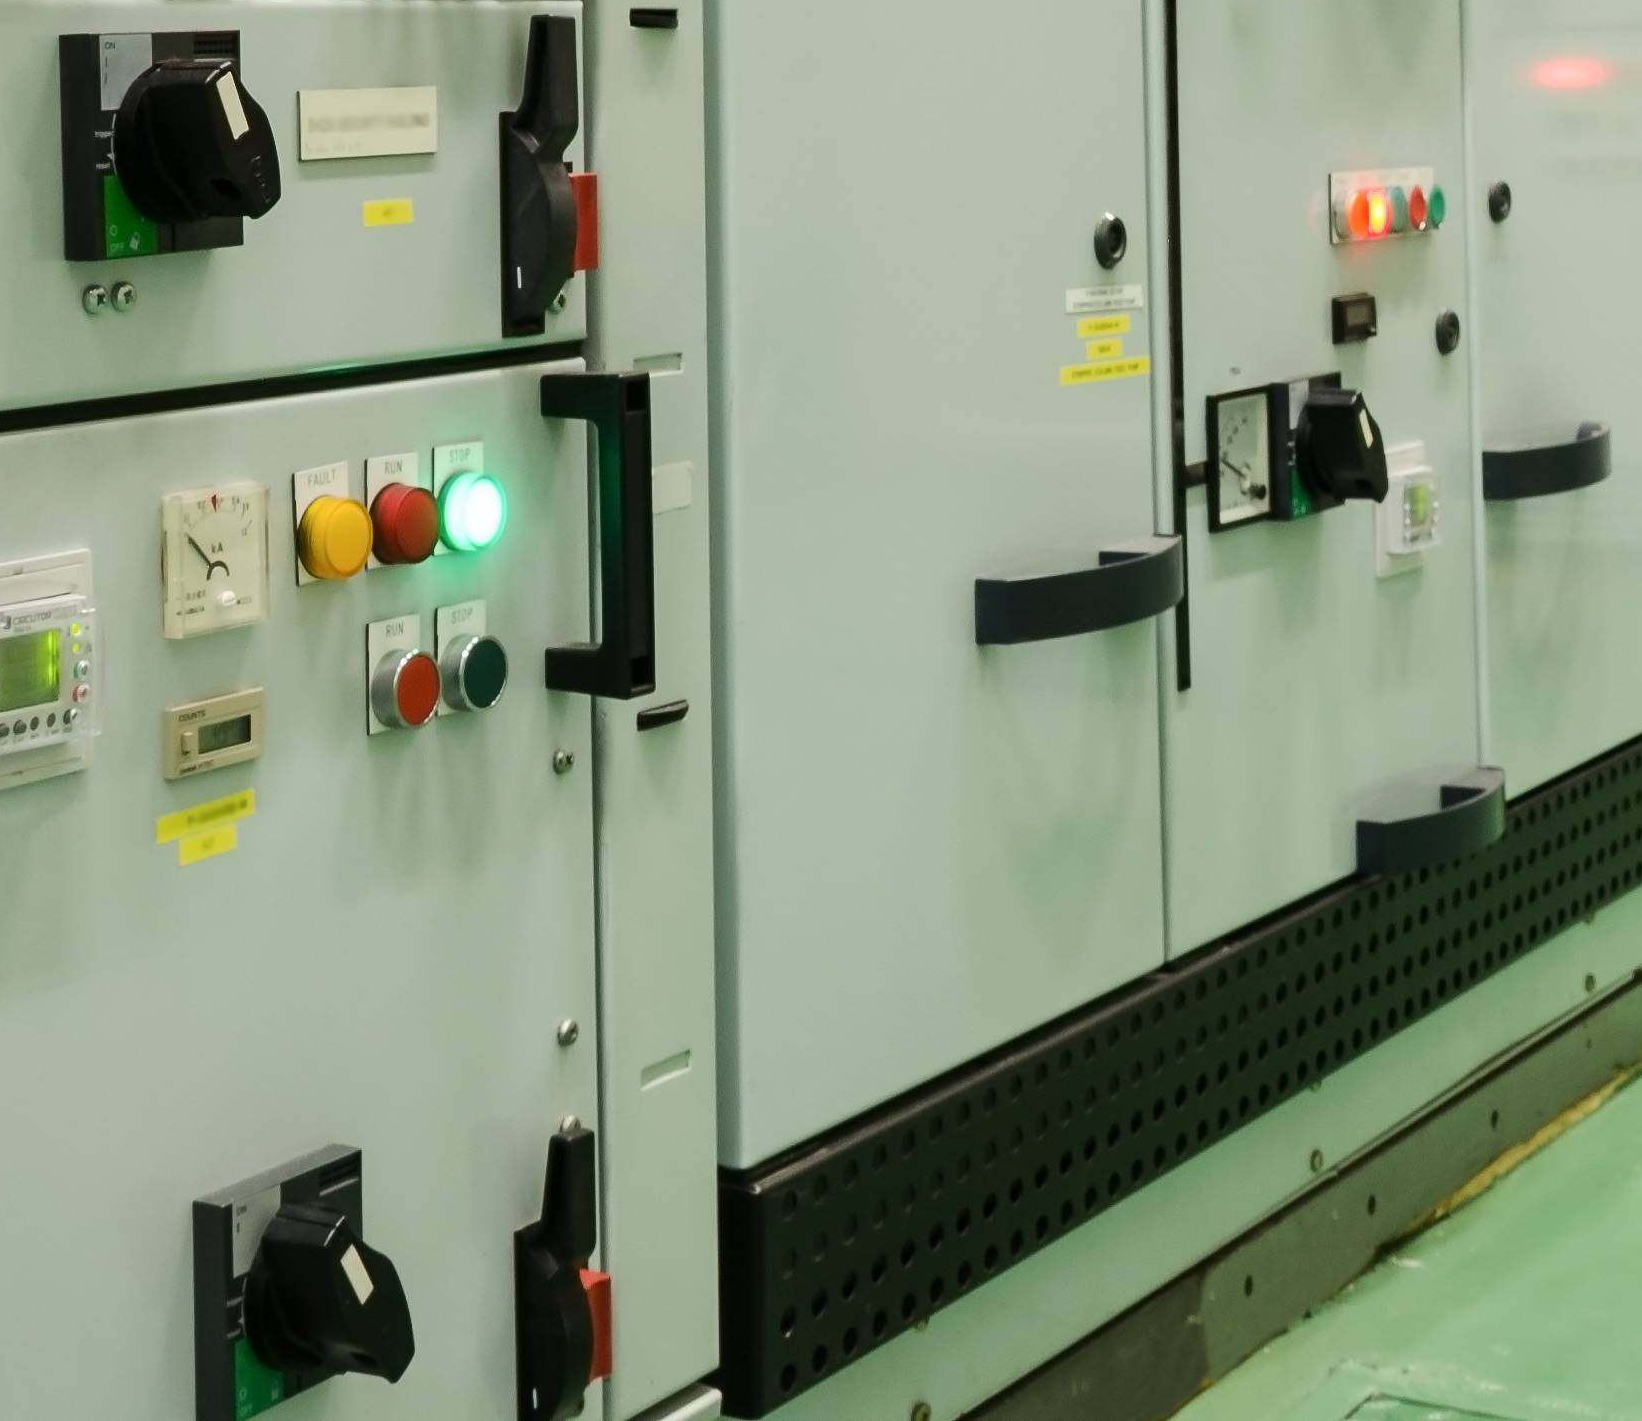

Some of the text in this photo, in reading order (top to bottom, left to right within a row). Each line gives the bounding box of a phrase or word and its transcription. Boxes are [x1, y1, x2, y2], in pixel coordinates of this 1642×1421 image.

[448, 448, 471, 464] STOP
[384, 459, 403, 475] RUN
[307, 468, 337, 487] FAULT
[451, 606, 473, 625] STOP
[385, 621, 404, 638] RUN
